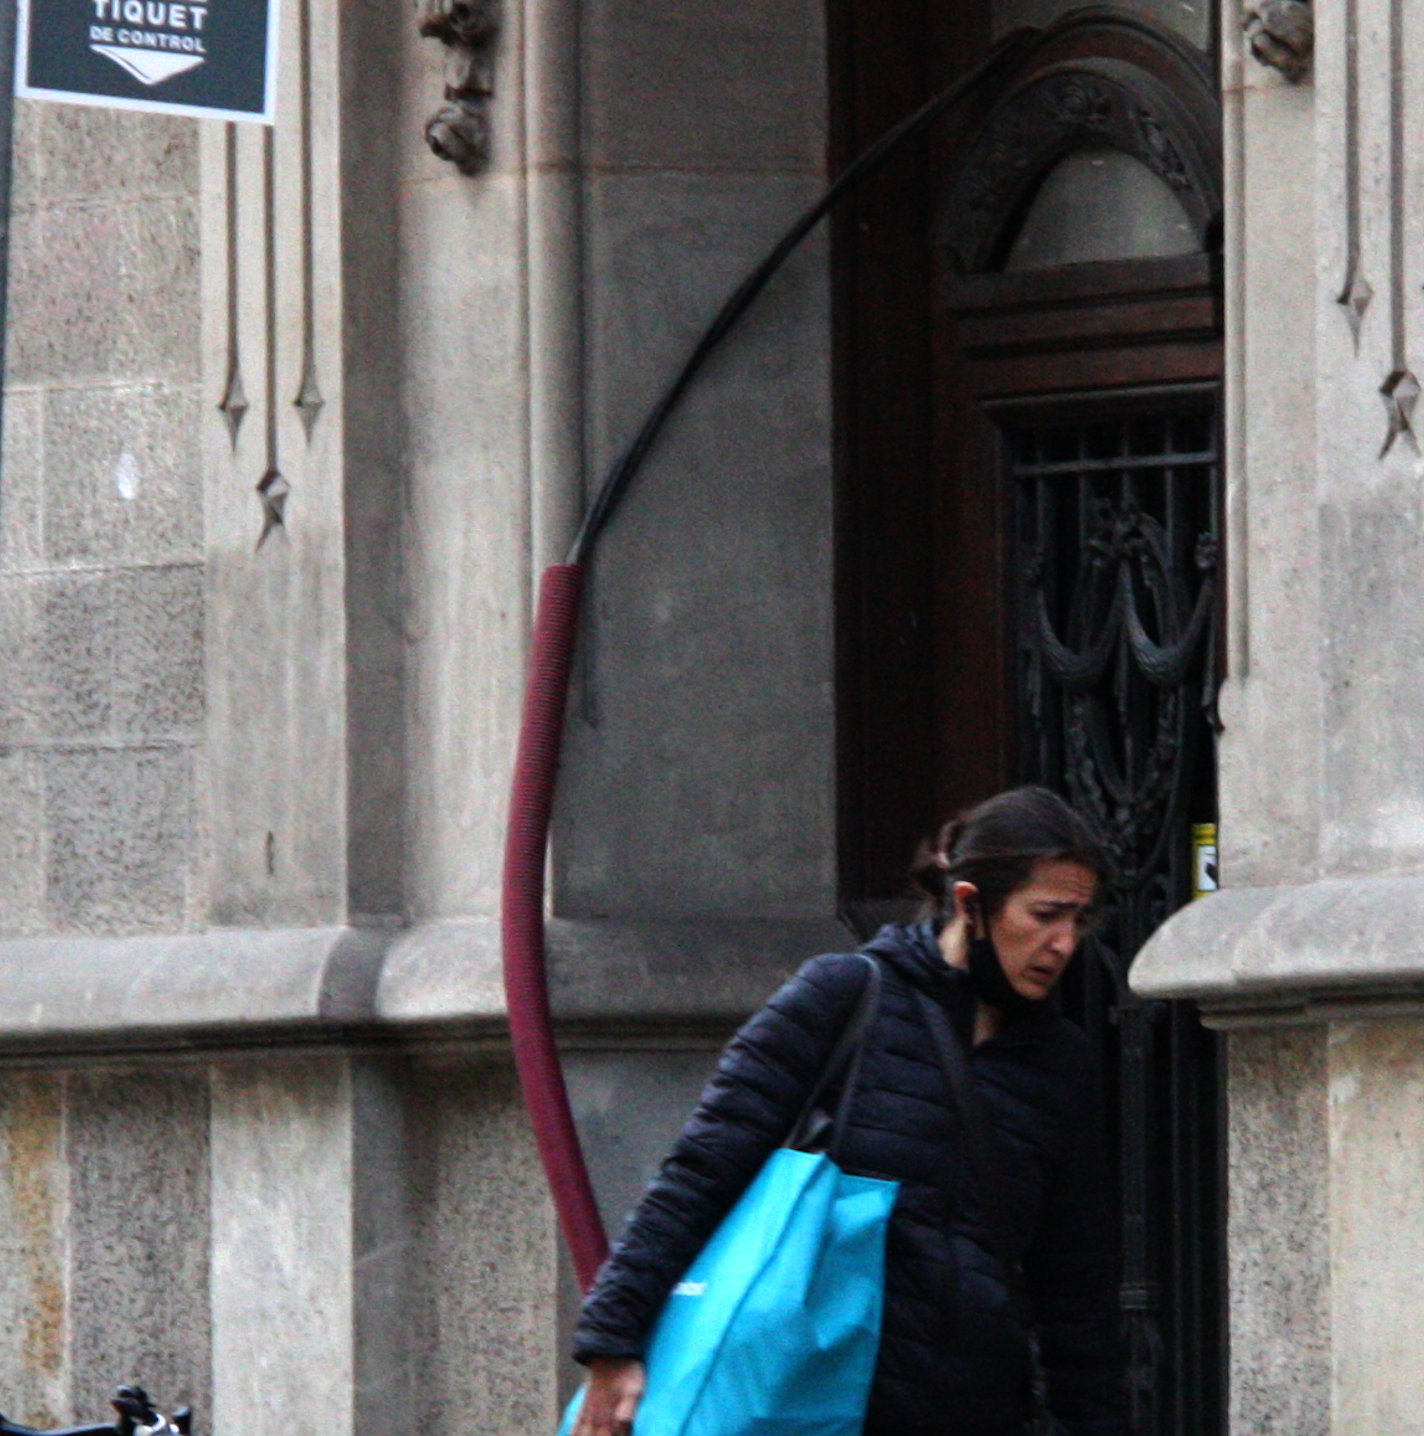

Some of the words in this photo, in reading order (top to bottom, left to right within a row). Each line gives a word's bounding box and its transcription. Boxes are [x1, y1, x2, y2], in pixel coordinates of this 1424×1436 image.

[93, 0, 208, 30] TIQUET
[89, 25, 114, 42] DE
[117, 28, 207, 52] CONTROL
